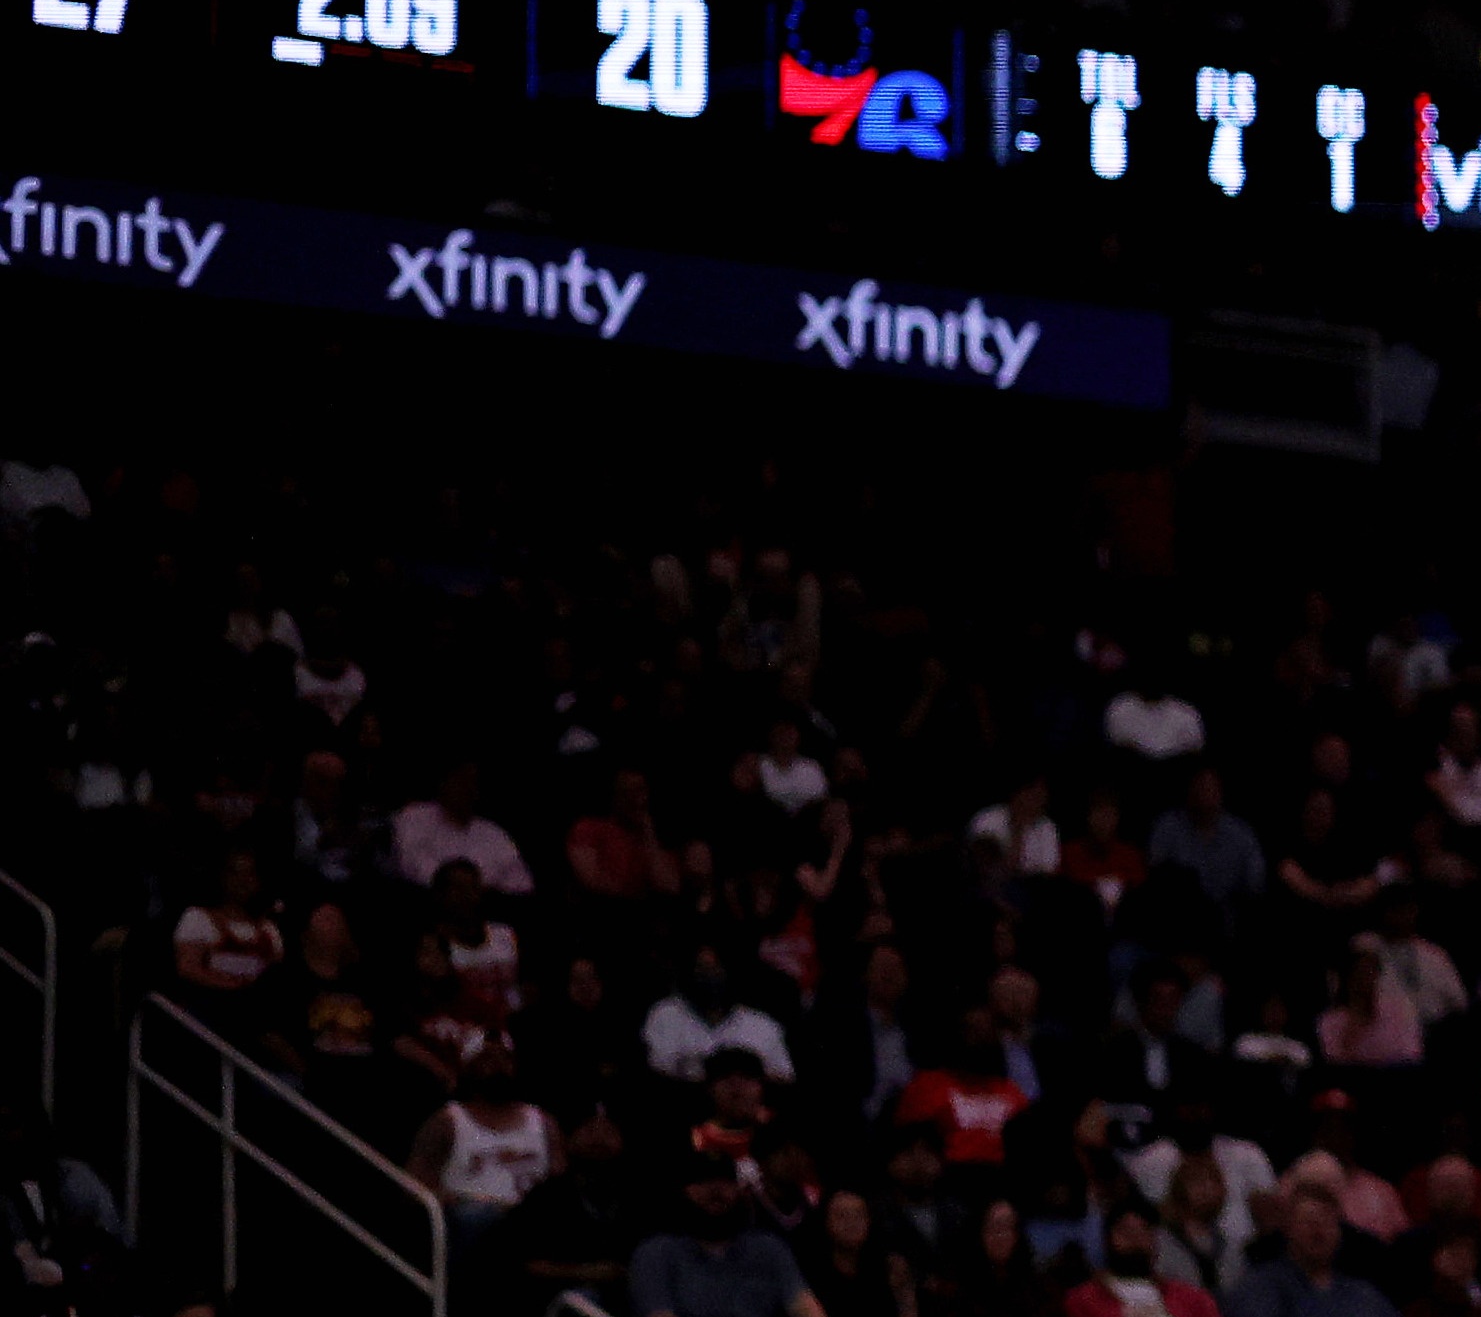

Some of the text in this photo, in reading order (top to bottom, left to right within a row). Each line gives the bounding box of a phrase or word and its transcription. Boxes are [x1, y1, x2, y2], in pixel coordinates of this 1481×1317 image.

[0, 177, 1039, 388] finity xfinity xfinity
